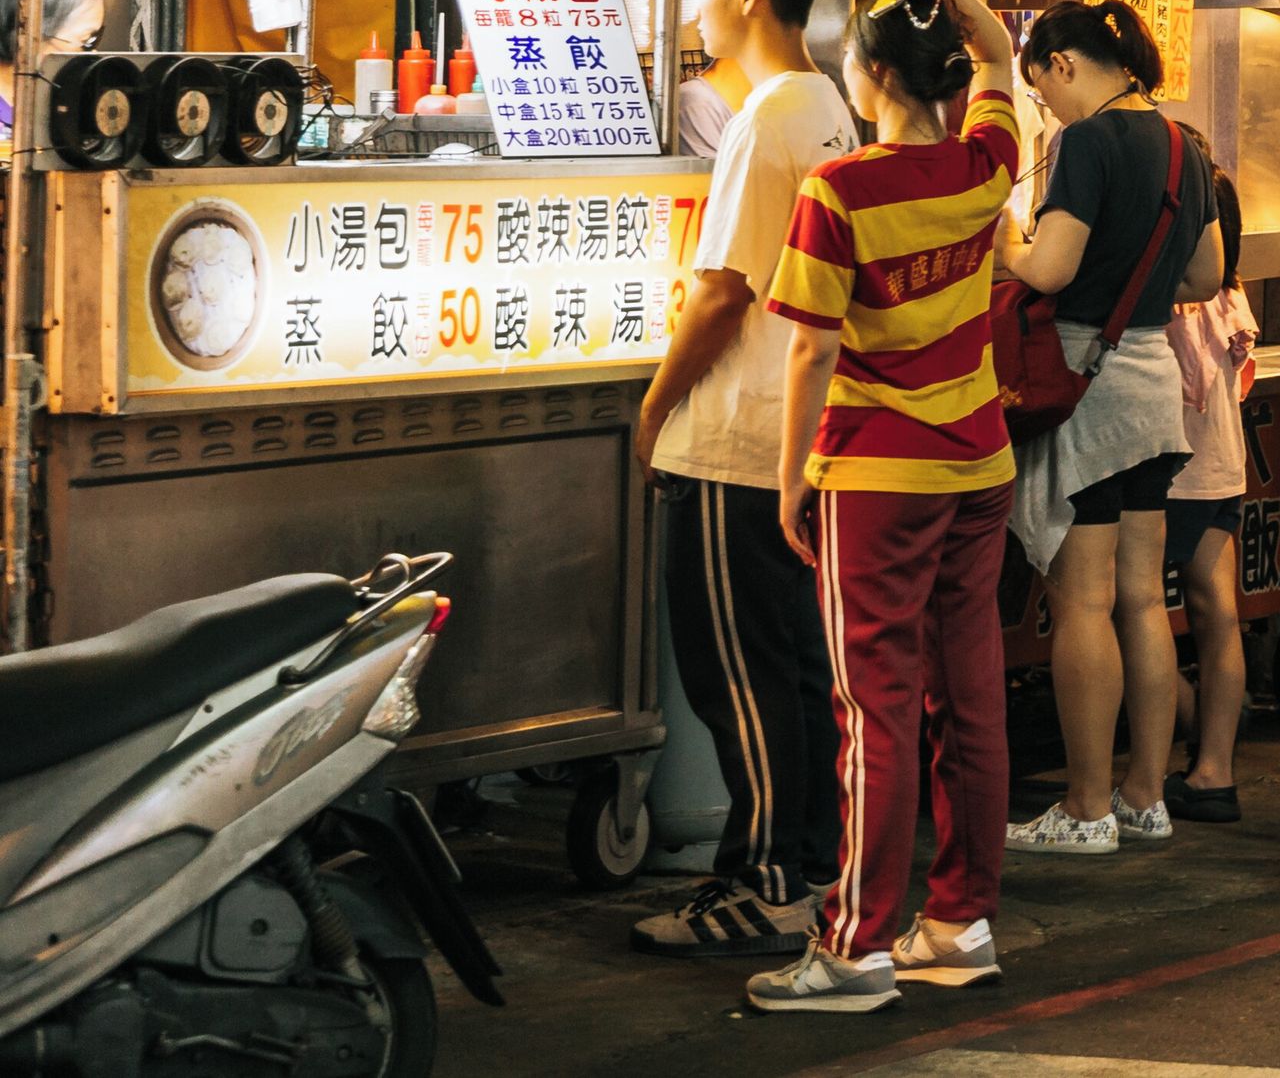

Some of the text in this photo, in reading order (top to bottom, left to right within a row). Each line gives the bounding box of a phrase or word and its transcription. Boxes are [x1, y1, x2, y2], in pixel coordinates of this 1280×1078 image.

[506, 35, 608, 71] 蒸餃
[286, 201, 411, 273] 小湯包
[442, 204, 483, 264] 75
[497, 196, 650, 264] 酸辣湯餃
[284, 290, 410, 364] 蒸餃
[439, 286, 481, 348] 50
[494, 282, 645, 350] 酸辣湯
